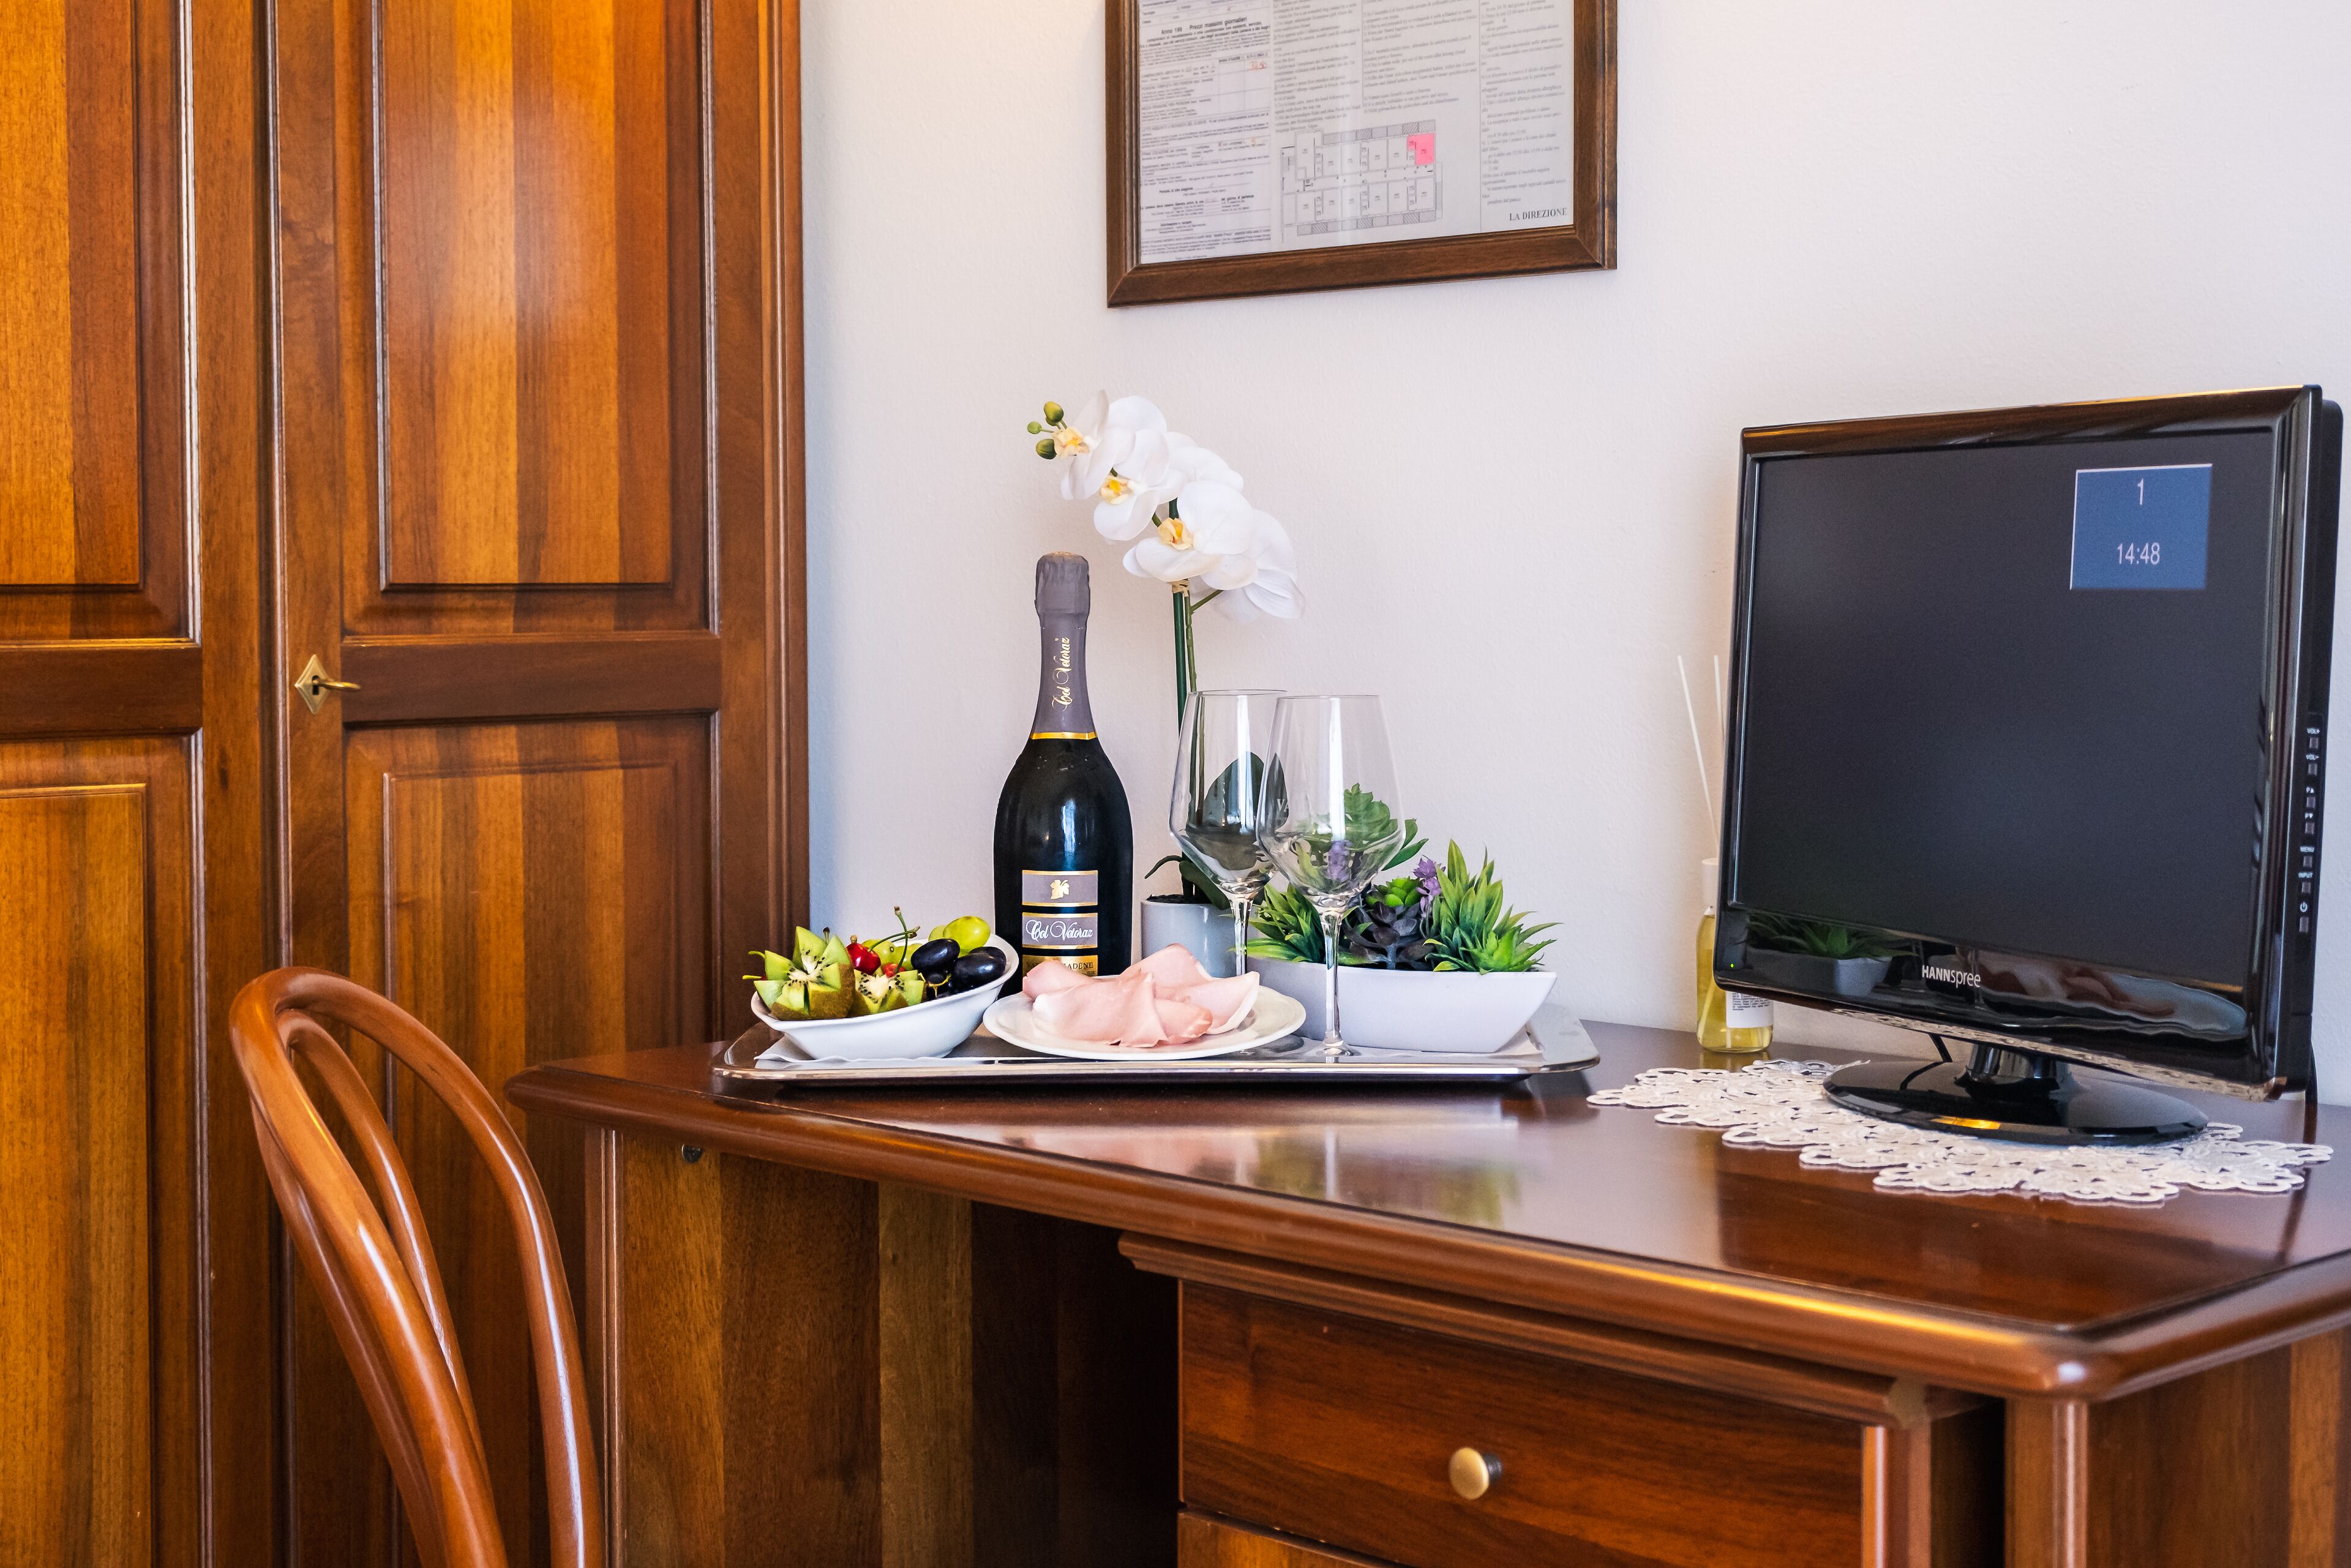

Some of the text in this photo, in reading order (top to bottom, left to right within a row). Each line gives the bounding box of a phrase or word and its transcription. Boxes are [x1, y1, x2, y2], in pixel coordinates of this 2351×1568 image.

[1224, 17, 1248, 26] giornalieri
[1522, 208, 1567, 220] DIREZIONE
[2137, 478, 2144, 505] 1
[2117, 541, 2161, 566] 14:48
[1922, 964, 1981, 989] HANNspree
